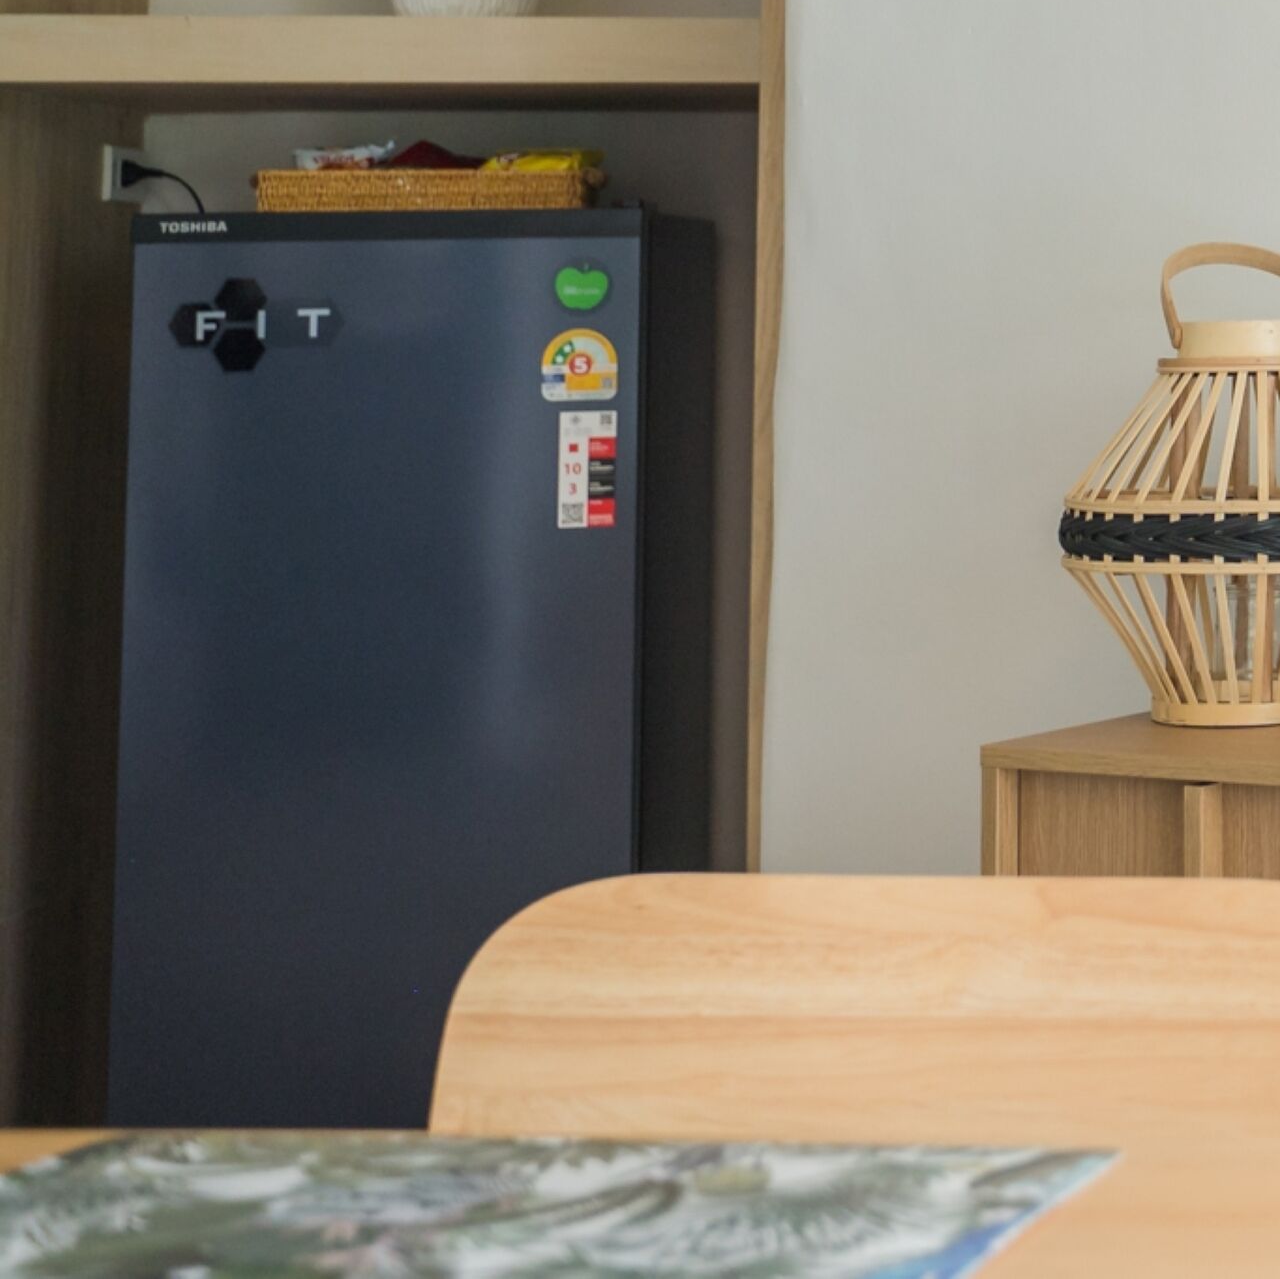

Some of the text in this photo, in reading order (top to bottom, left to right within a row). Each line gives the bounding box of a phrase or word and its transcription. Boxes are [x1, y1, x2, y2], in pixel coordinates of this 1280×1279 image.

[159, 221, 228, 234] TOSHIBA
[574, 357, 588, 374] 5
[565, 463, 582, 475] 10
